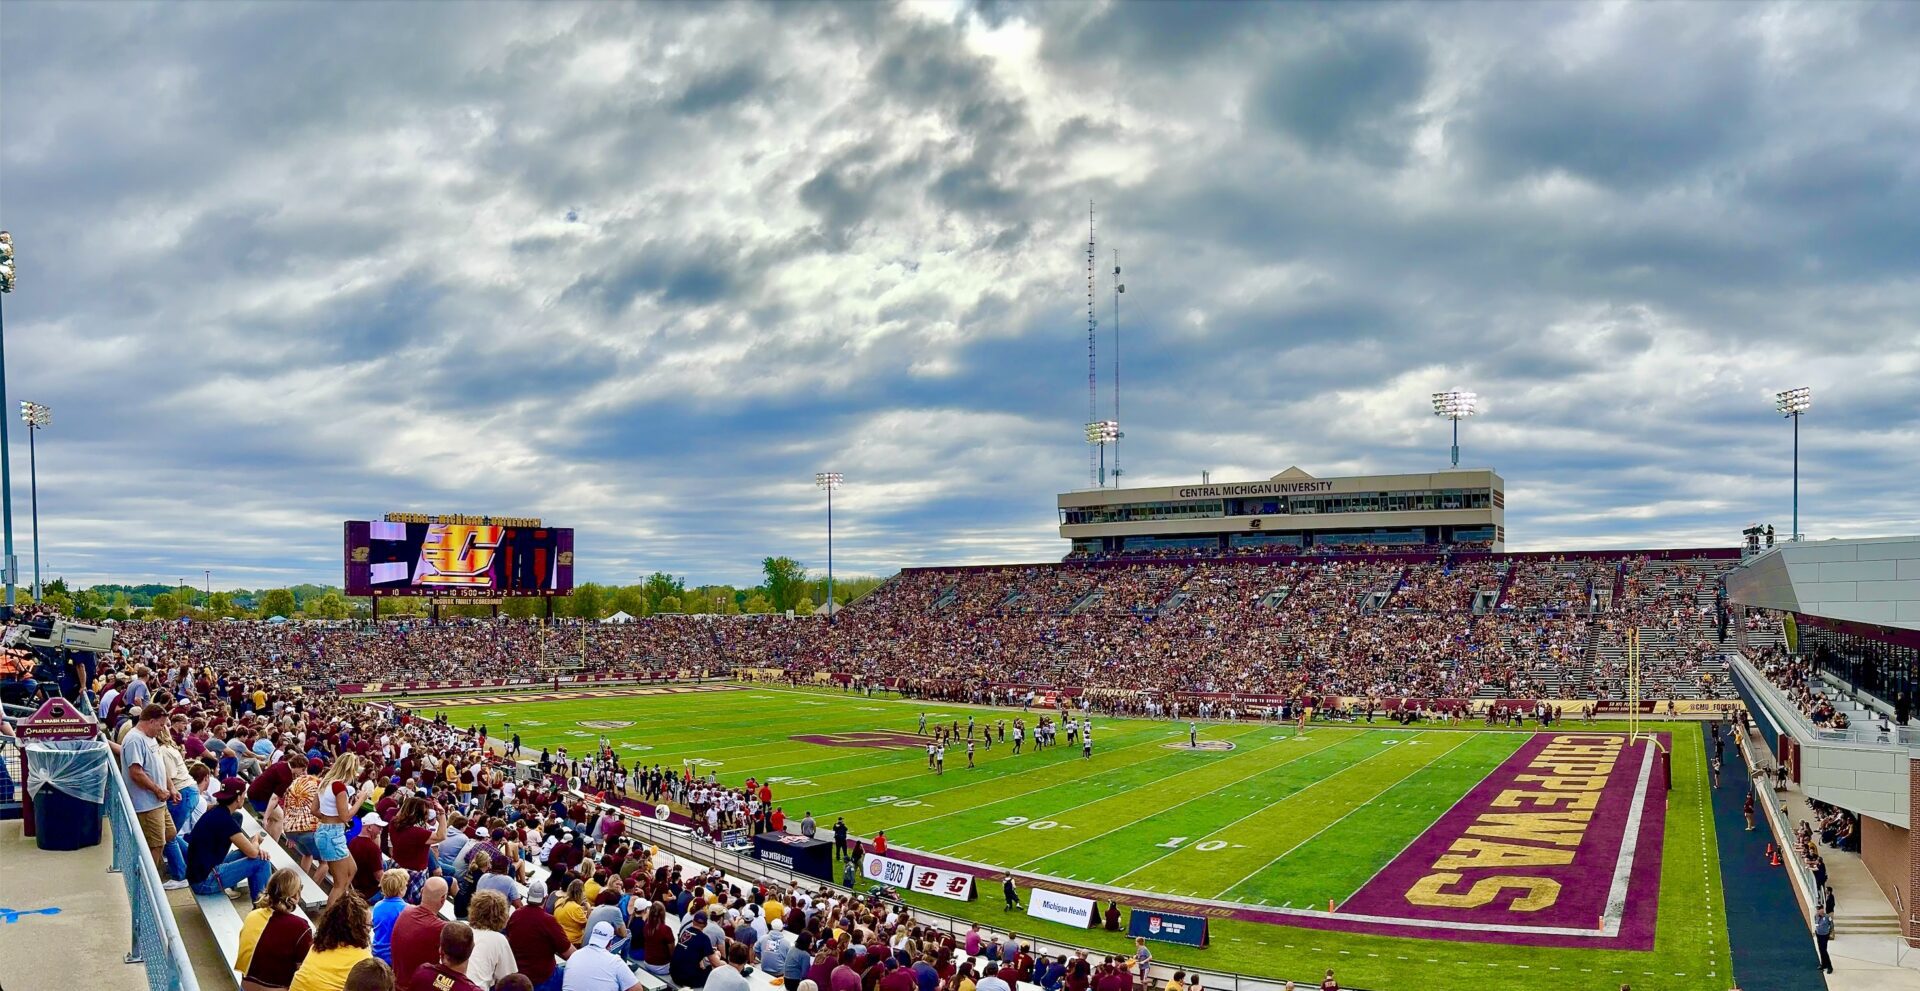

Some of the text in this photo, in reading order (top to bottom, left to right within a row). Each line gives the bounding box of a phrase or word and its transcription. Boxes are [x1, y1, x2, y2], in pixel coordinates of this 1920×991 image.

[1180, 481, 1333, 498] CENTRAL MICHIGAN UNIVERSITY
[389, 512, 429, 523] CENTRAL
[438, 514, 484, 526] MICHIGAN
[460, 589, 478, 597] 15:00
[1404, 735, 1625, 912] CHIPPEWAS
[1156, 836, 1229, 851] 10
[761, 850, 793, 864] SAN DIEGO STATE
[1043, 900, 1087, 917] Michigan Health
[436, 974, 455, 987] CMU
